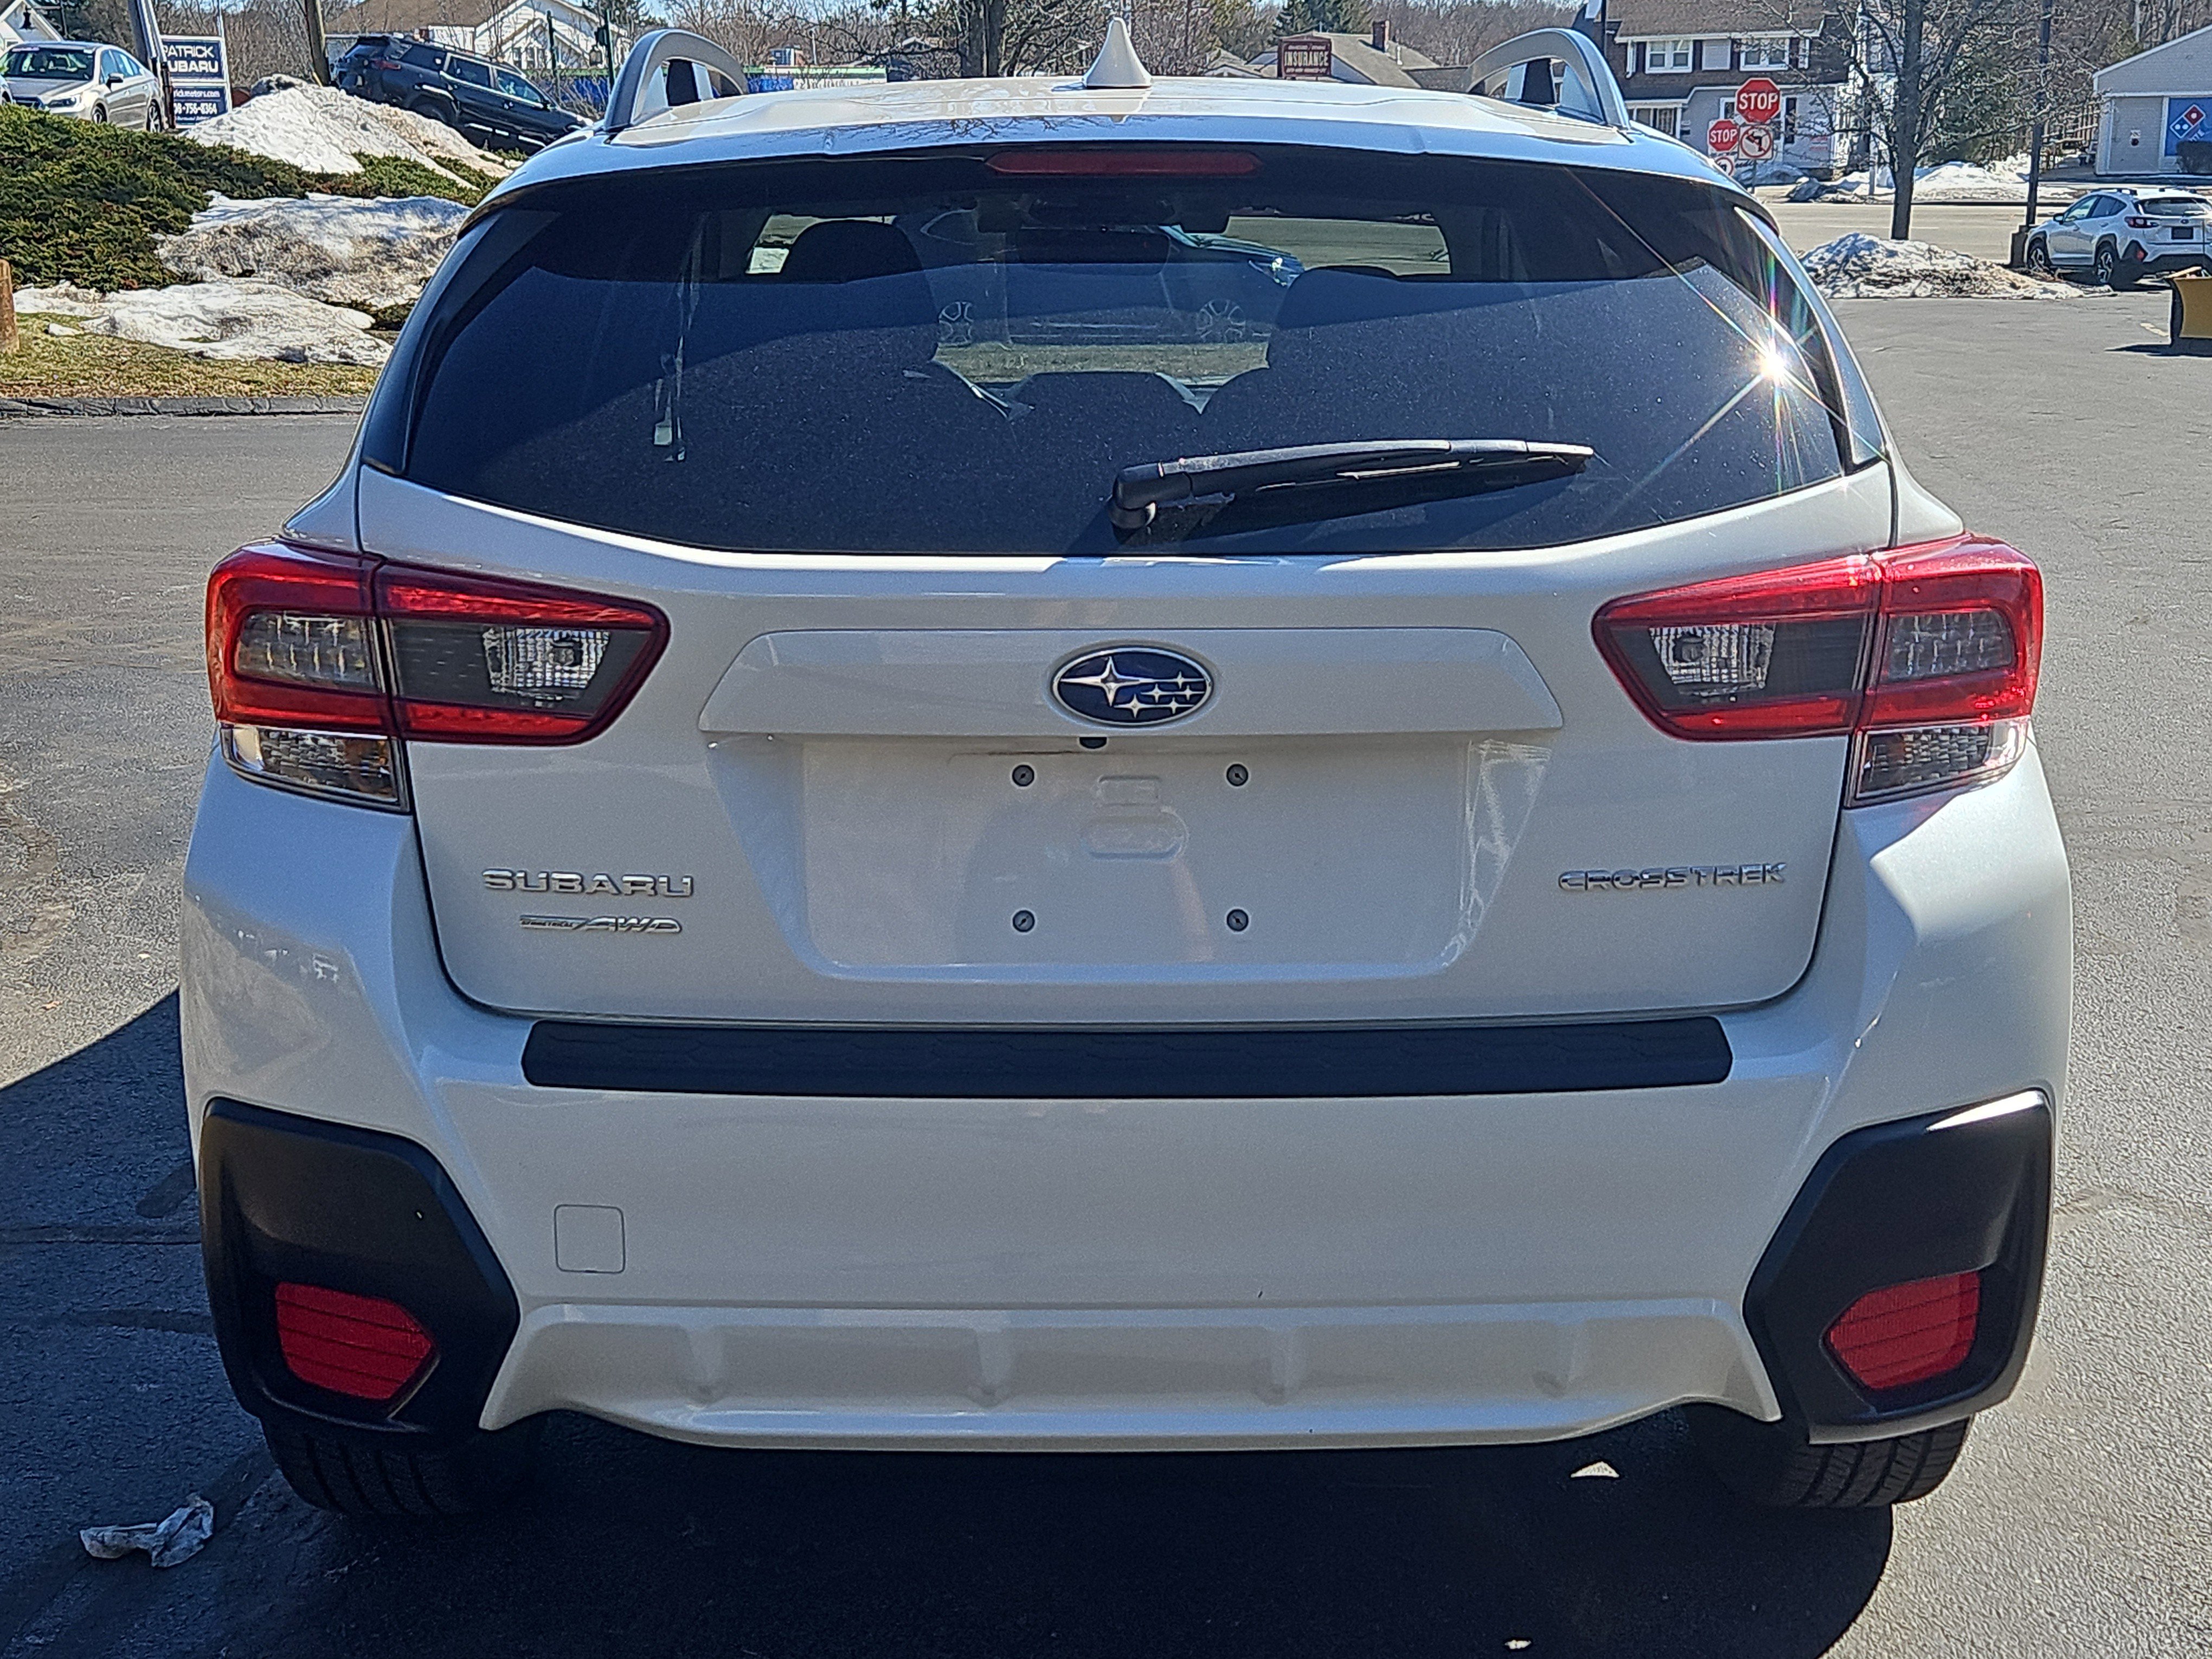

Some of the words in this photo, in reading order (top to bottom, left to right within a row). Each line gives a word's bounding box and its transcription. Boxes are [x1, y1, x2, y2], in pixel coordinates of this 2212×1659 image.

[163, 44, 215, 58] PATRICK
[1284, 51, 1329, 67] INSURANCE
[167, 60, 218, 73] UBARU
[1738, 92, 1778, 110] STOP
[1709, 128, 1738, 143] STOP
[482, 869, 693, 897] SUBARU
[1558, 863, 1787, 890] CROSSTREK
[584, 916, 682, 933] AWD
